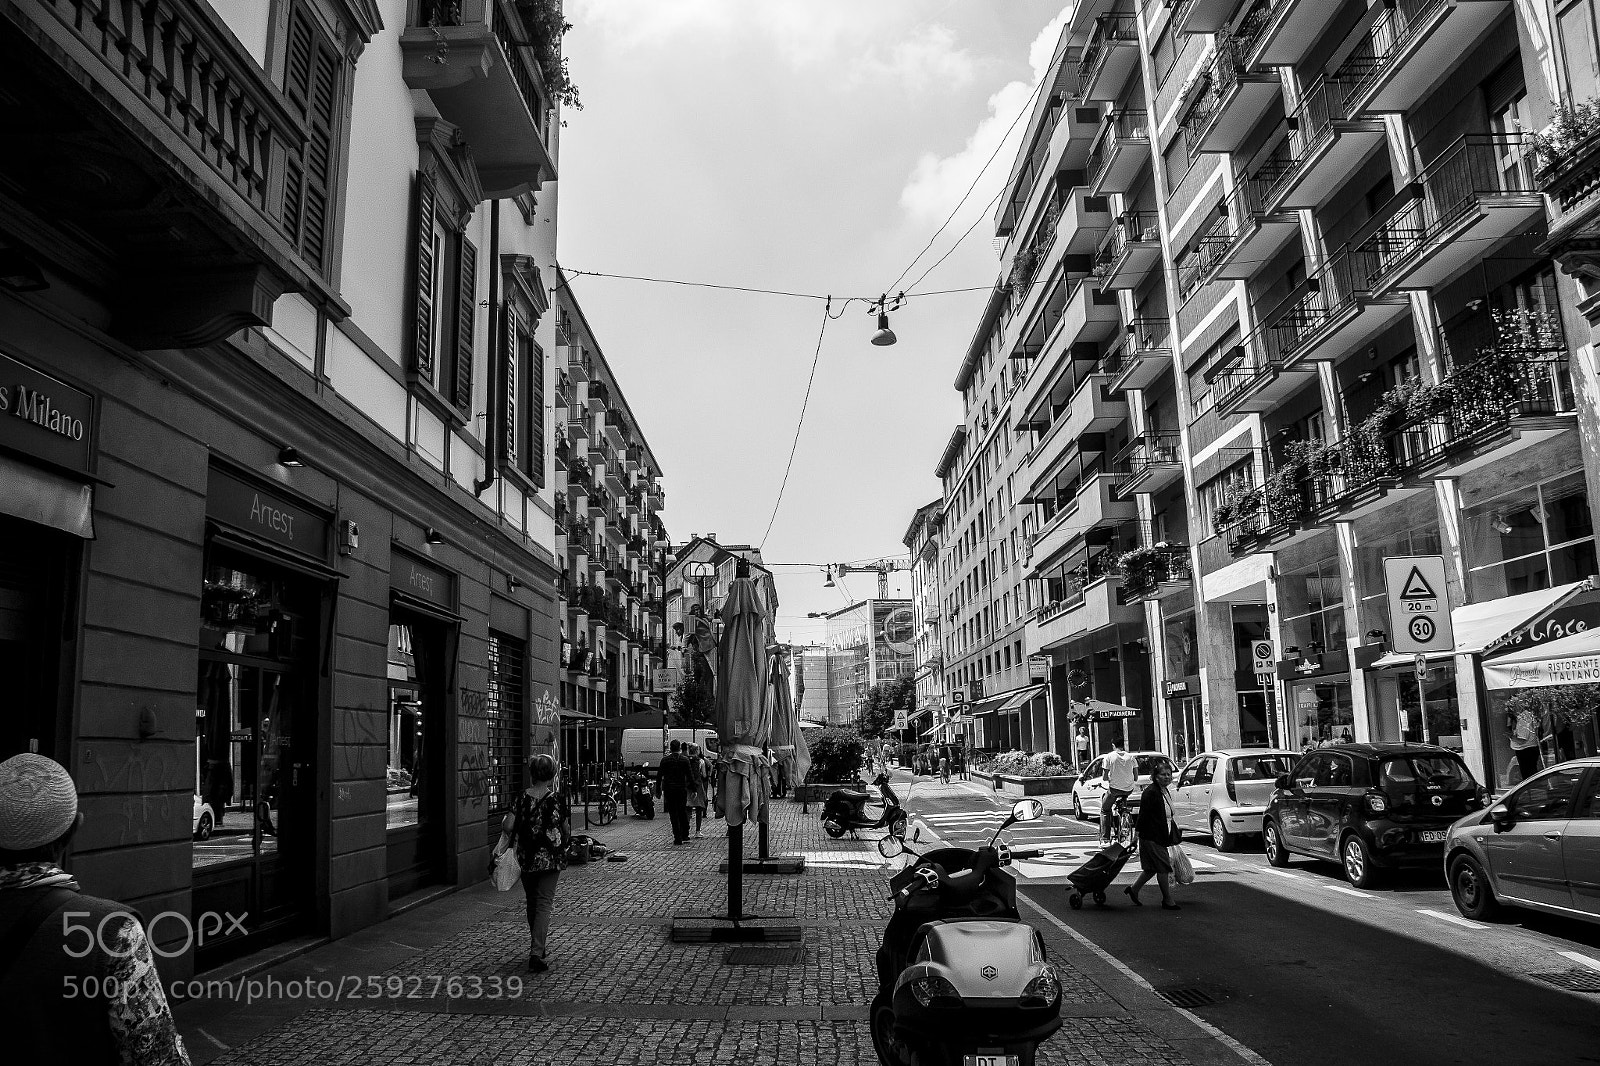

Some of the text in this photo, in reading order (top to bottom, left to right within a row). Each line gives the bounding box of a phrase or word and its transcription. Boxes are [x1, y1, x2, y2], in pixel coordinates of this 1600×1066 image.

[16, 385, 83, 441] Milano
[250, 493, 294, 540] Artest
[1408, 603, 1421, 611] 20
[1414, 623, 1430, 636] 30
[1529, 619, 1588, 641] Grace
[1548, 658, 1599, 672] RISTORANTE
[1549, 669, 1600, 682] ITALIANO
[962, 704, 970, 715] P
